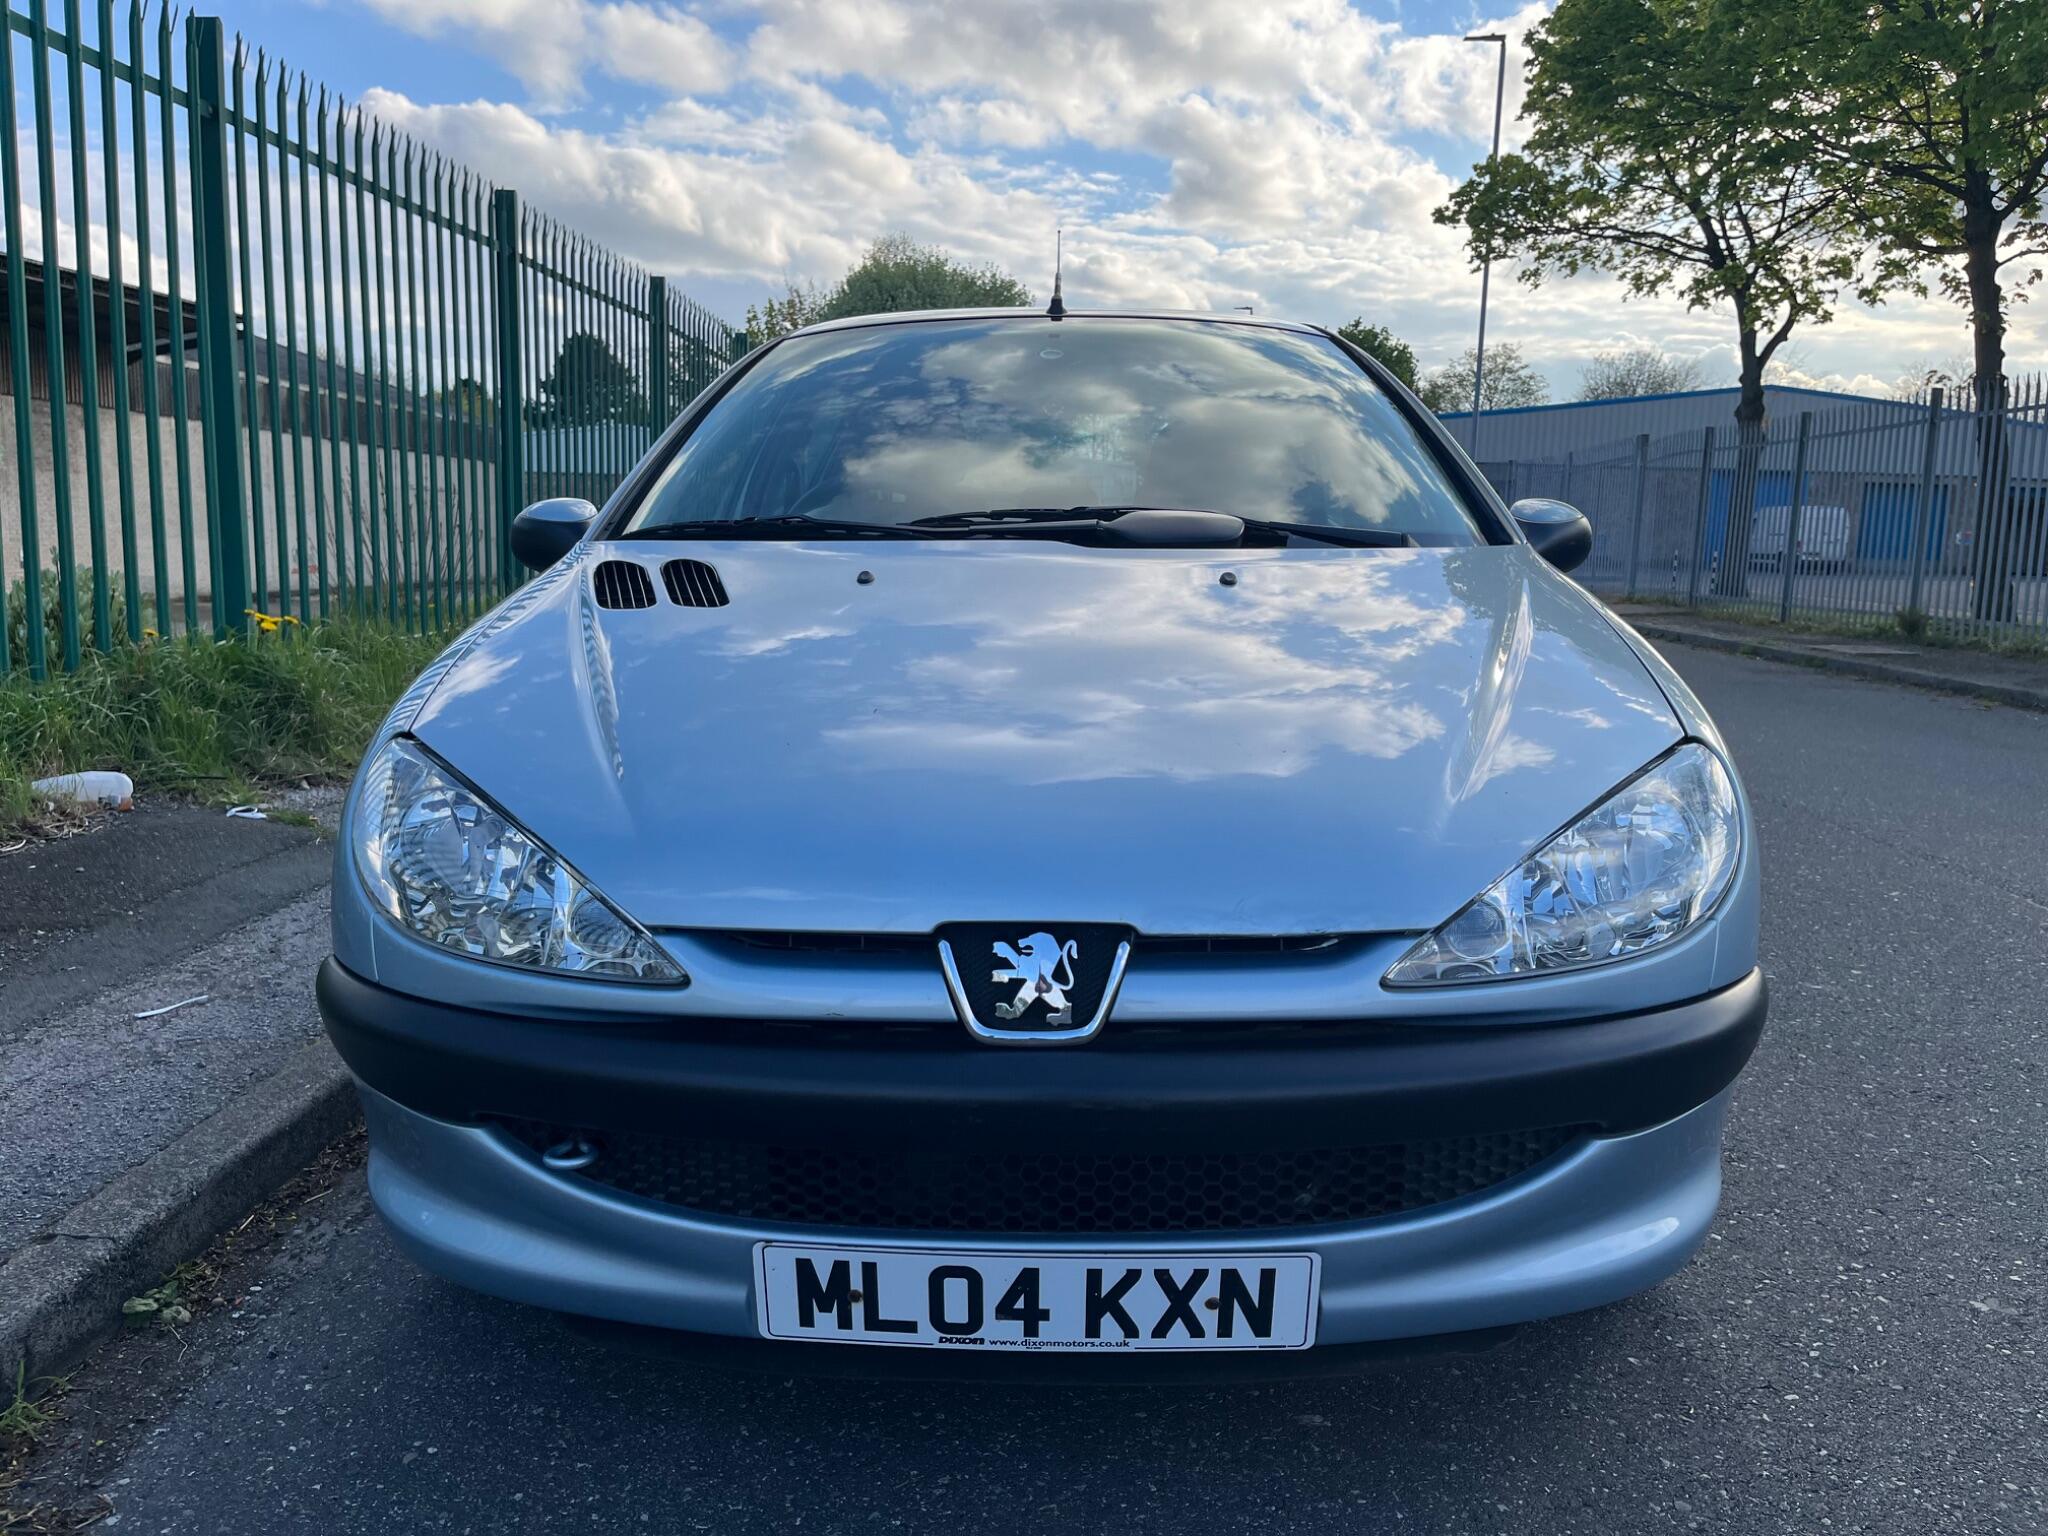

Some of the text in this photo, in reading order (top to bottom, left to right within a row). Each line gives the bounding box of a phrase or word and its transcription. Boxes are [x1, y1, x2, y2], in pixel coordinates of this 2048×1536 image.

[795, 1257, 1276, 1339] ML04 KXN
[989, 1338, 1130, 1348] www.dixonmotors.co.uk
